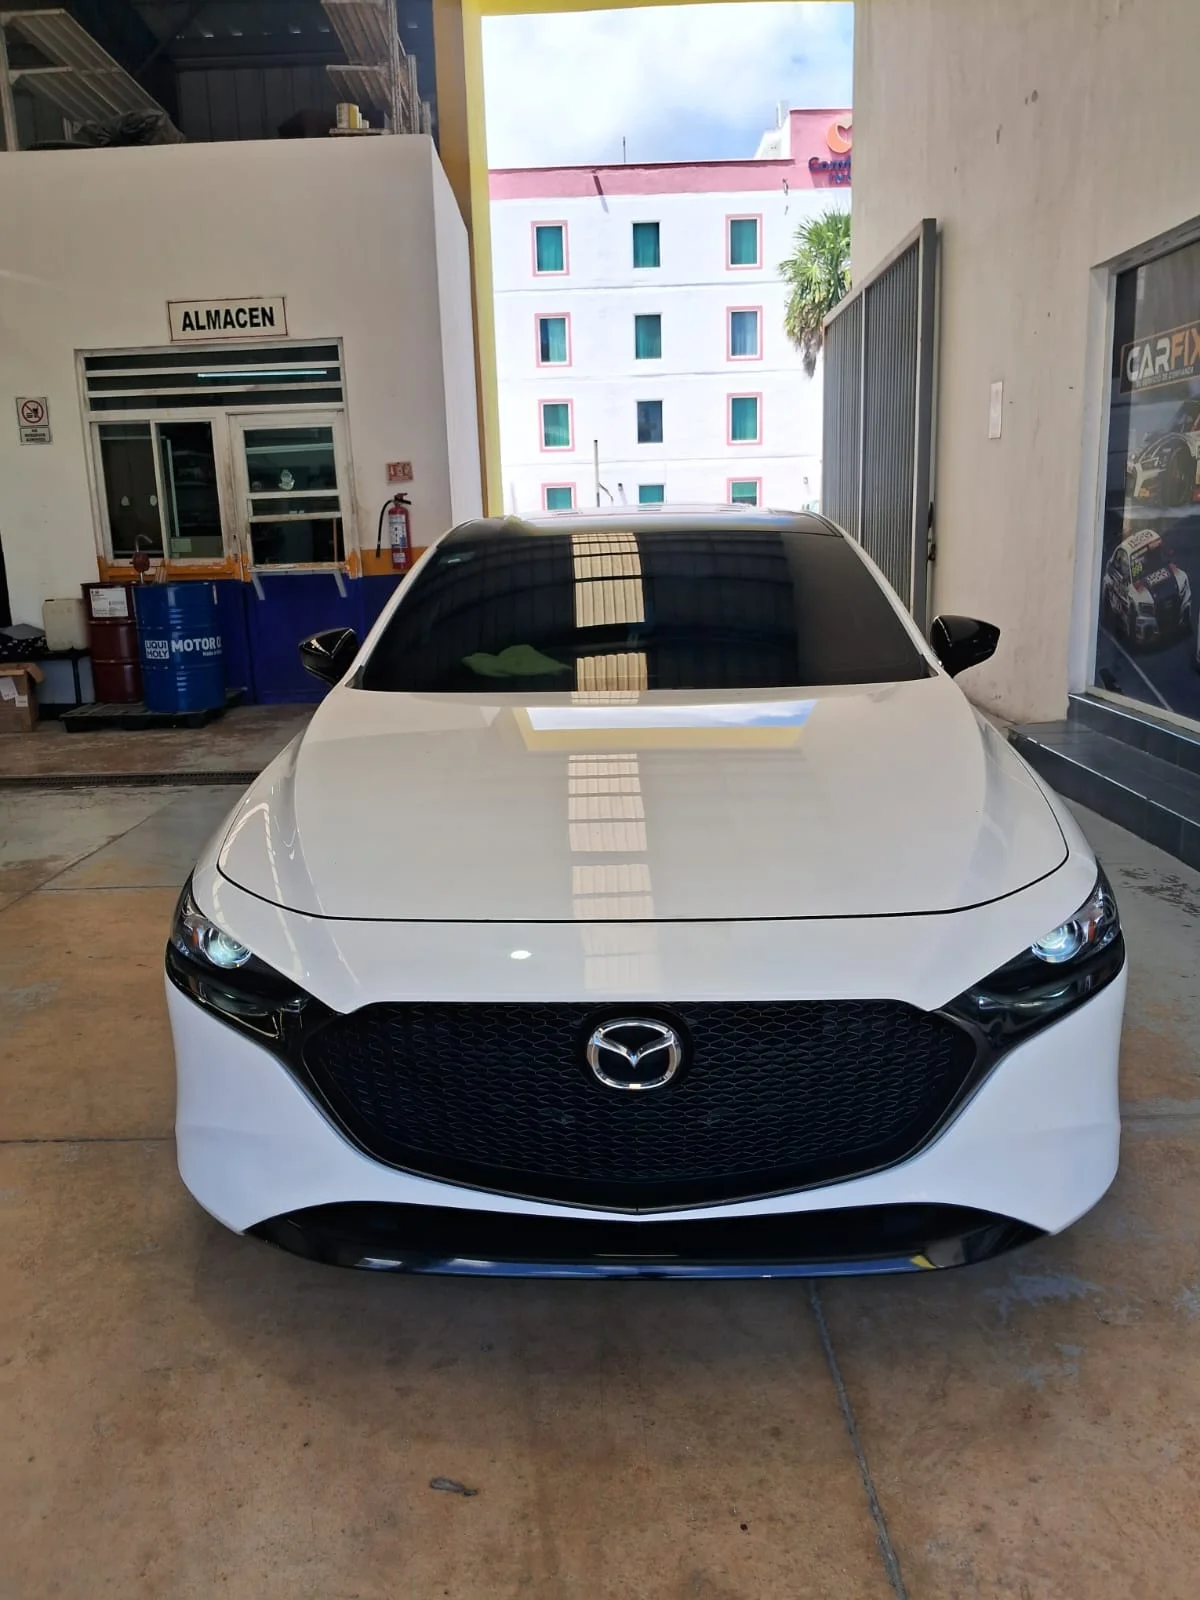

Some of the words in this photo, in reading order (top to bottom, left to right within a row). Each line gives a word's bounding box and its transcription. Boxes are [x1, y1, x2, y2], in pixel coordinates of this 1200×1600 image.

[182, 306, 275, 332] ALMACEN
[171, 637, 216, 653] MOTOR
[146, 649, 169, 658] MOLY
